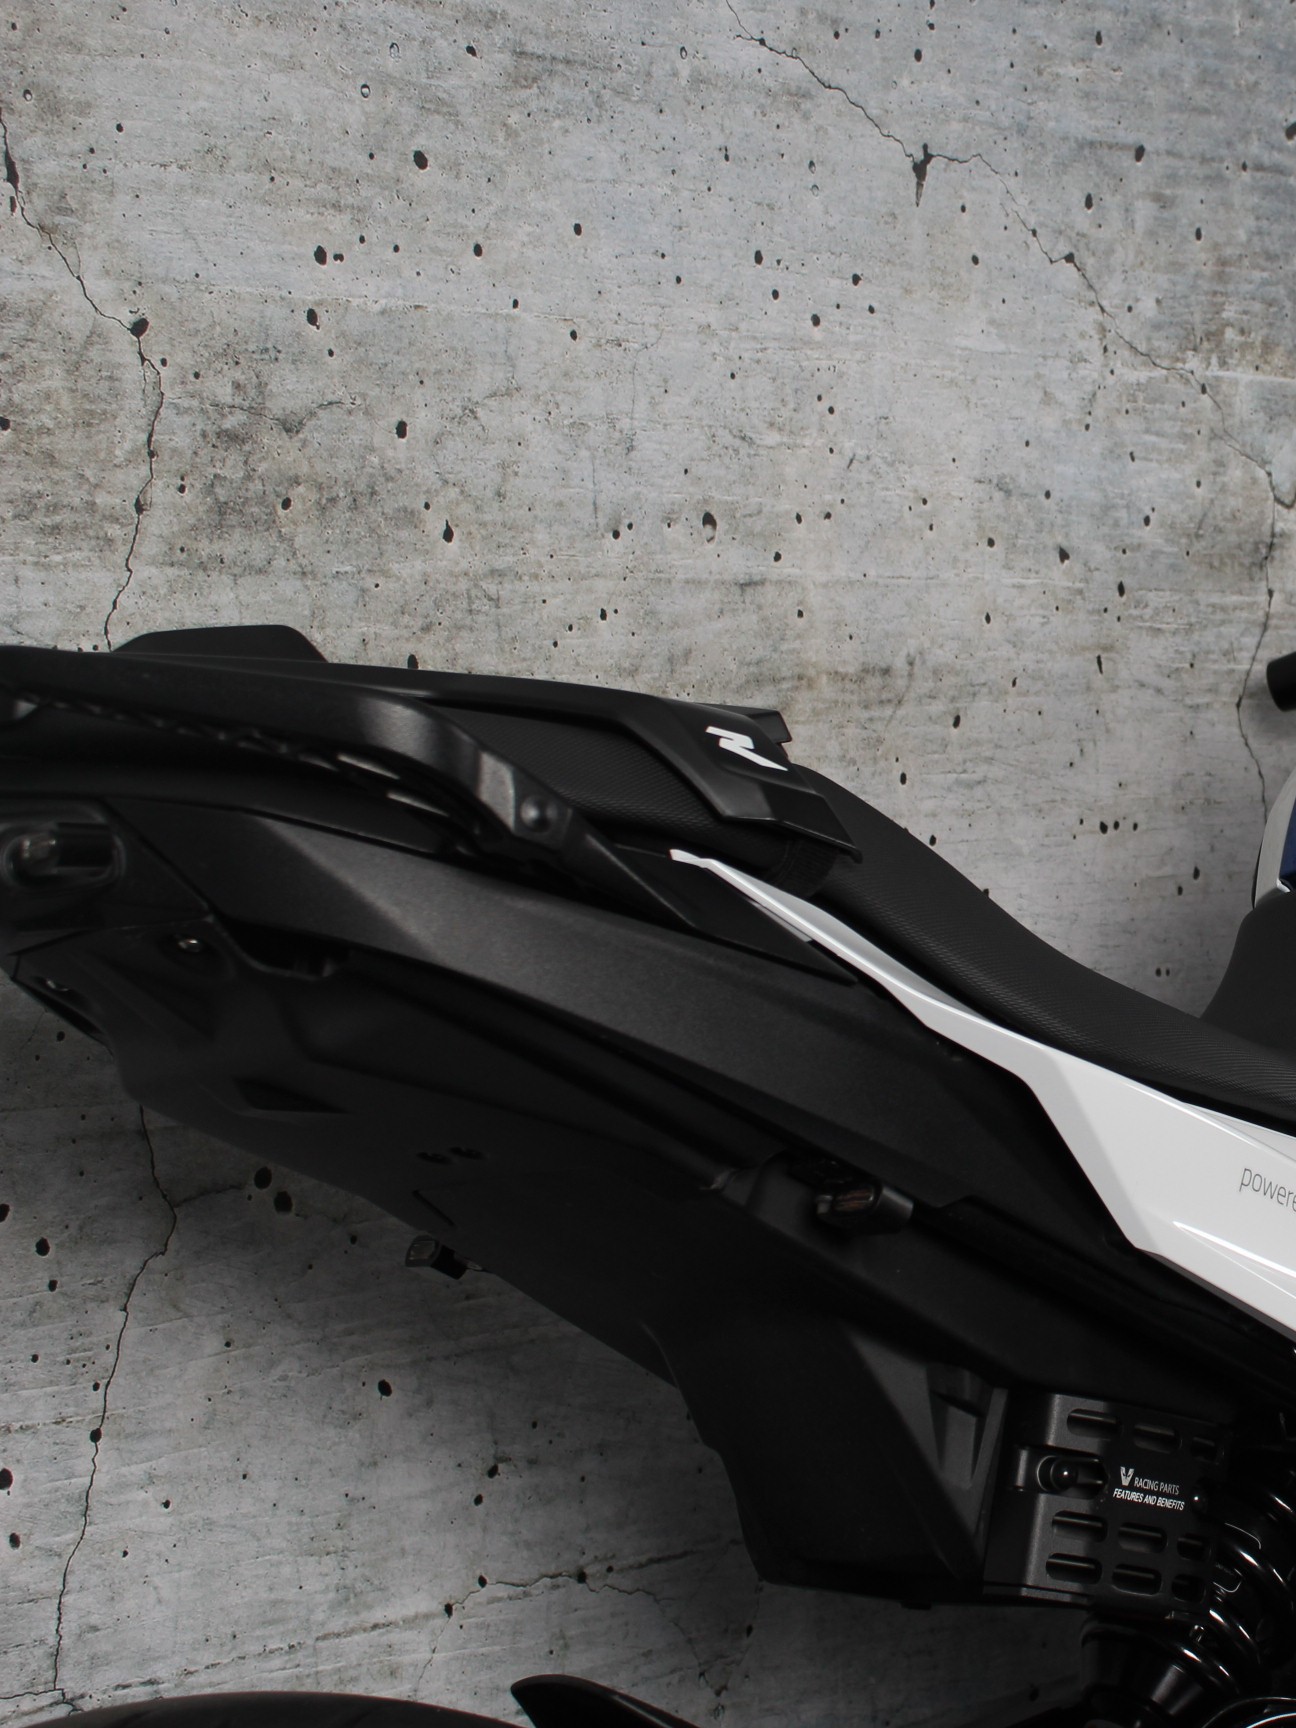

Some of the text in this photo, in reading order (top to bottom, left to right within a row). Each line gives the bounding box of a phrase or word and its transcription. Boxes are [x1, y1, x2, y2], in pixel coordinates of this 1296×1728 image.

[1134, 1477, 1159, 1491] RACING
[1159, 1481, 1180, 1495] PARTS
[1112, 1488, 1185, 1511] FEATURES AND BENEFITS
